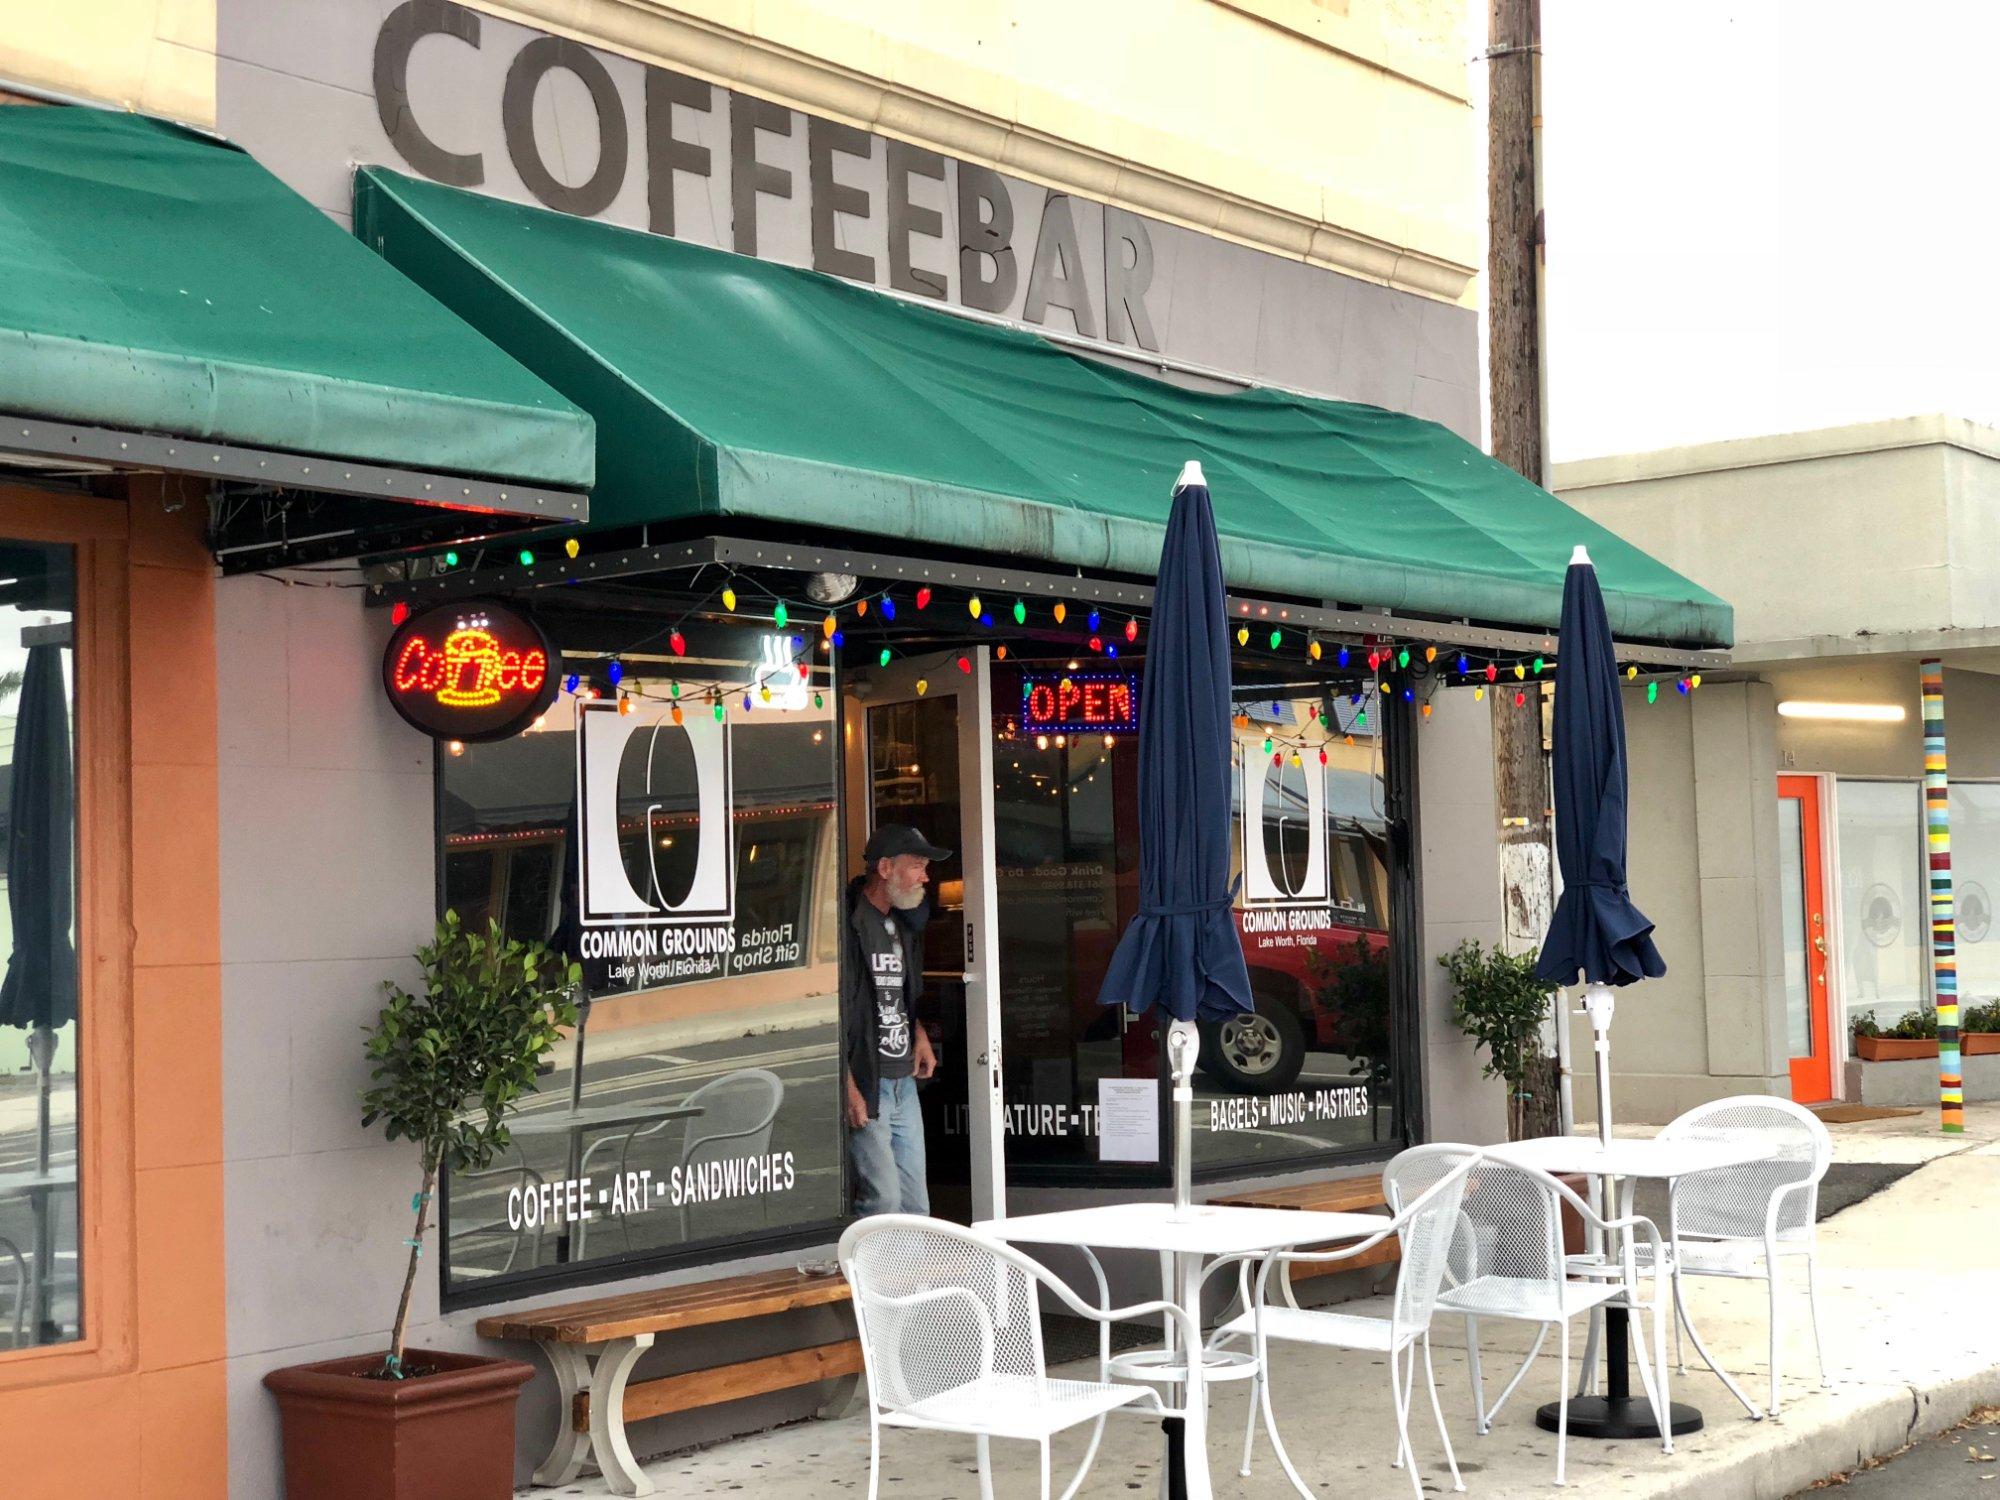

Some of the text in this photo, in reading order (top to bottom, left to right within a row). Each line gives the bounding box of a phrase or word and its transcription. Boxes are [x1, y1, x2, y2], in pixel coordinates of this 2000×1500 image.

[396, 638, 545, 690] Coffee
[1030, 684, 1129, 721] OPEN
[1242, 910, 1286, 933] COMMON
[1288, 909, 1331, 931] GROUNDS
[580, 927, 736, 959] COMMON GROUNDS
[1258, 937, 1274, 948] Lake
[1296, 934, 1317, 946] Florida
[608, 962, 636, 979] Lake
[1210, 1085, 1368, 1132] BAGELS MUSIC PASTRIES
[507, 1150, 795, 1231] COFFEE ART SANDWICHES
